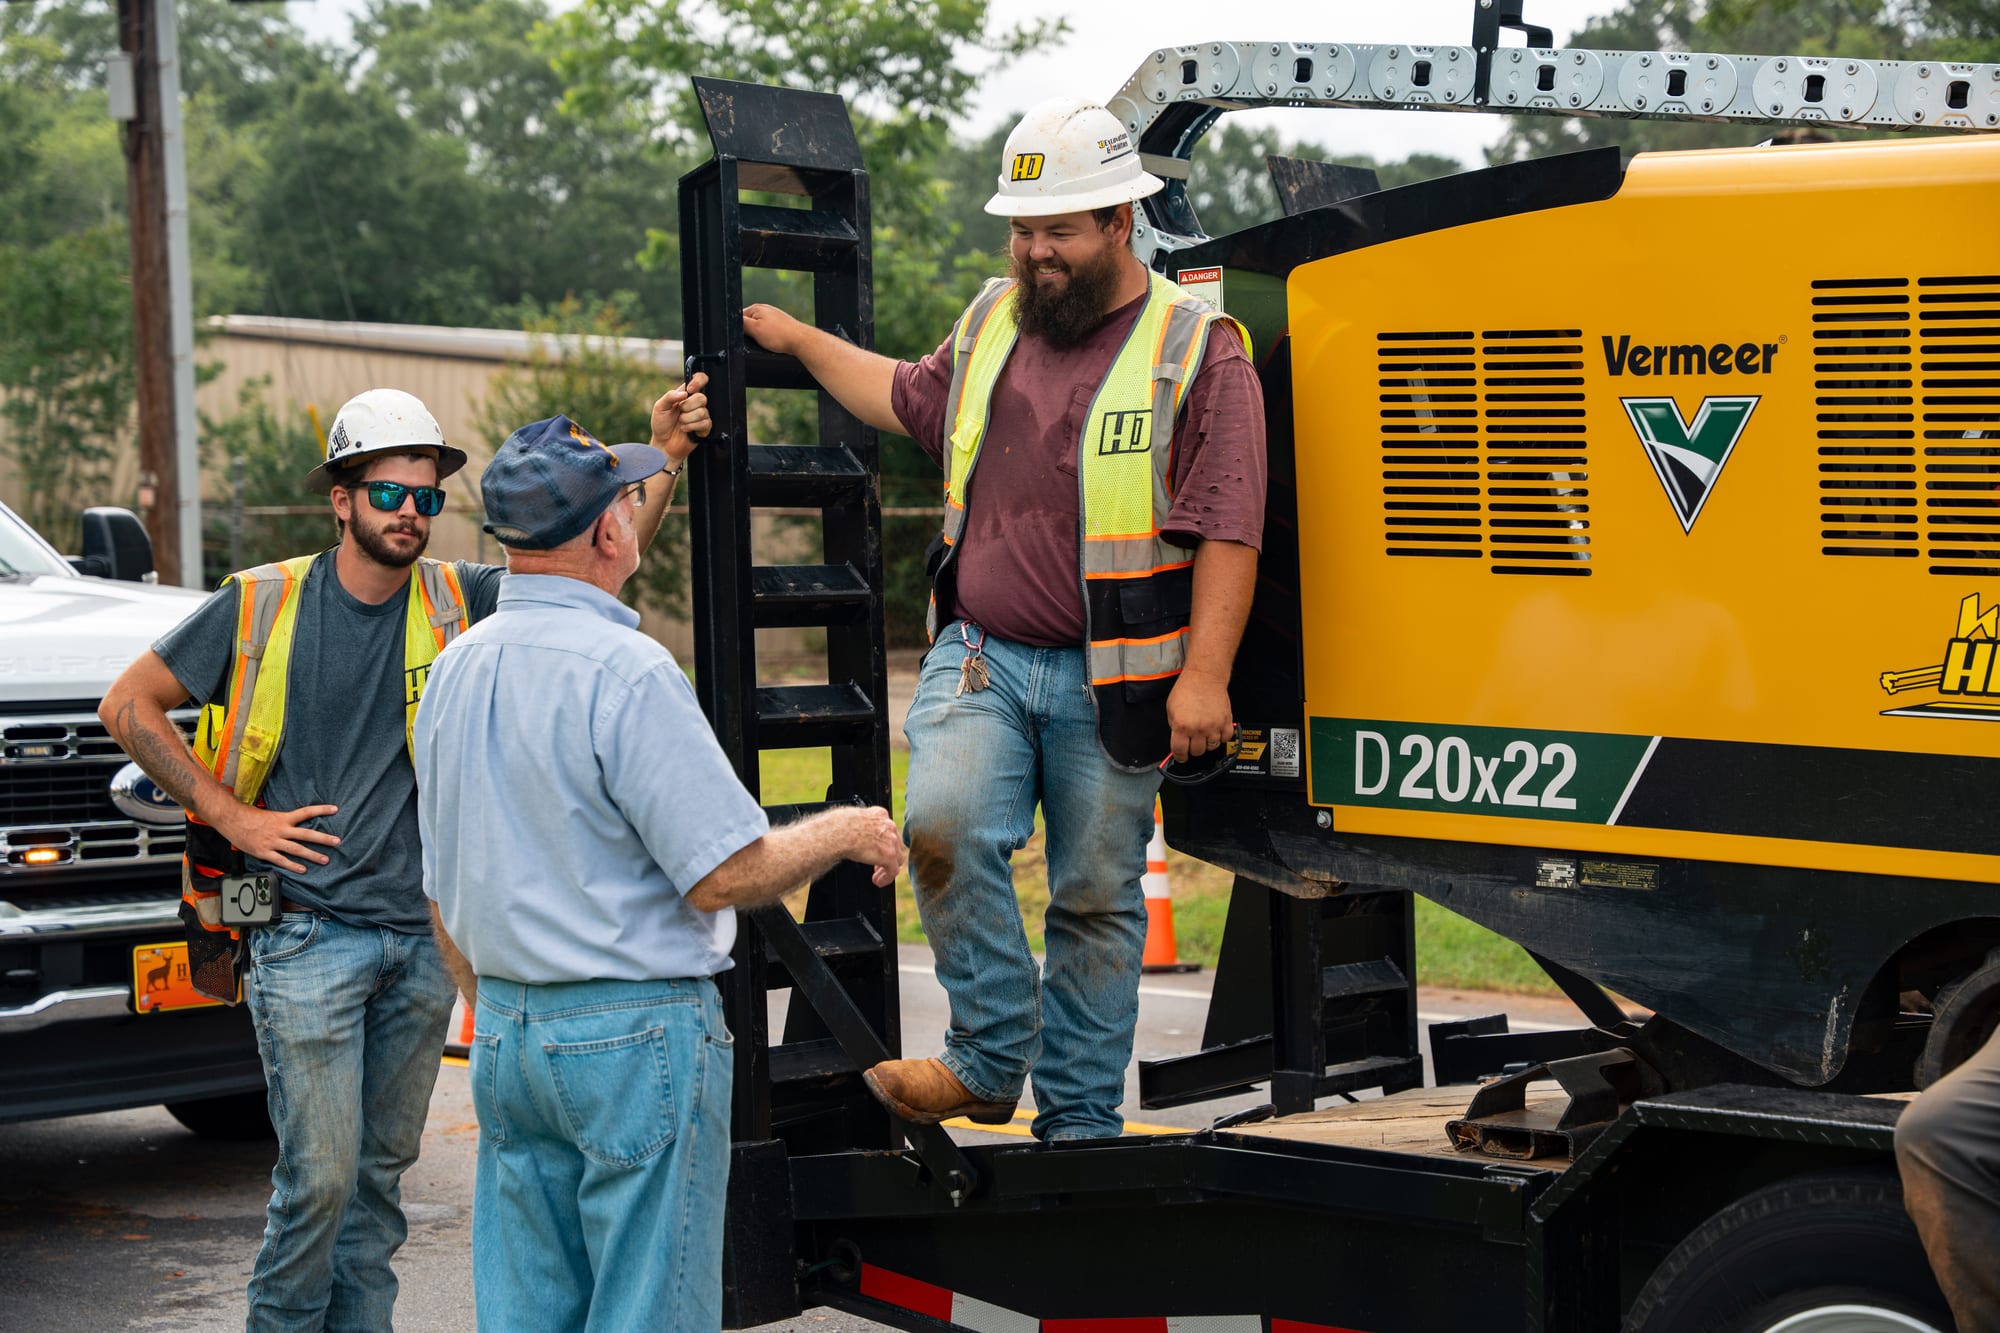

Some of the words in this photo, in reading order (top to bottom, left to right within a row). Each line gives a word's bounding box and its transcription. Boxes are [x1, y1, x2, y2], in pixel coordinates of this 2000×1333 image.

[1011, 153, 1045, 181] HD
[1188, 271, 1218, 281] DANGER
[1601, 335, 1779, 376] Vermeer
[1099, 409, 1152, 456] HD
